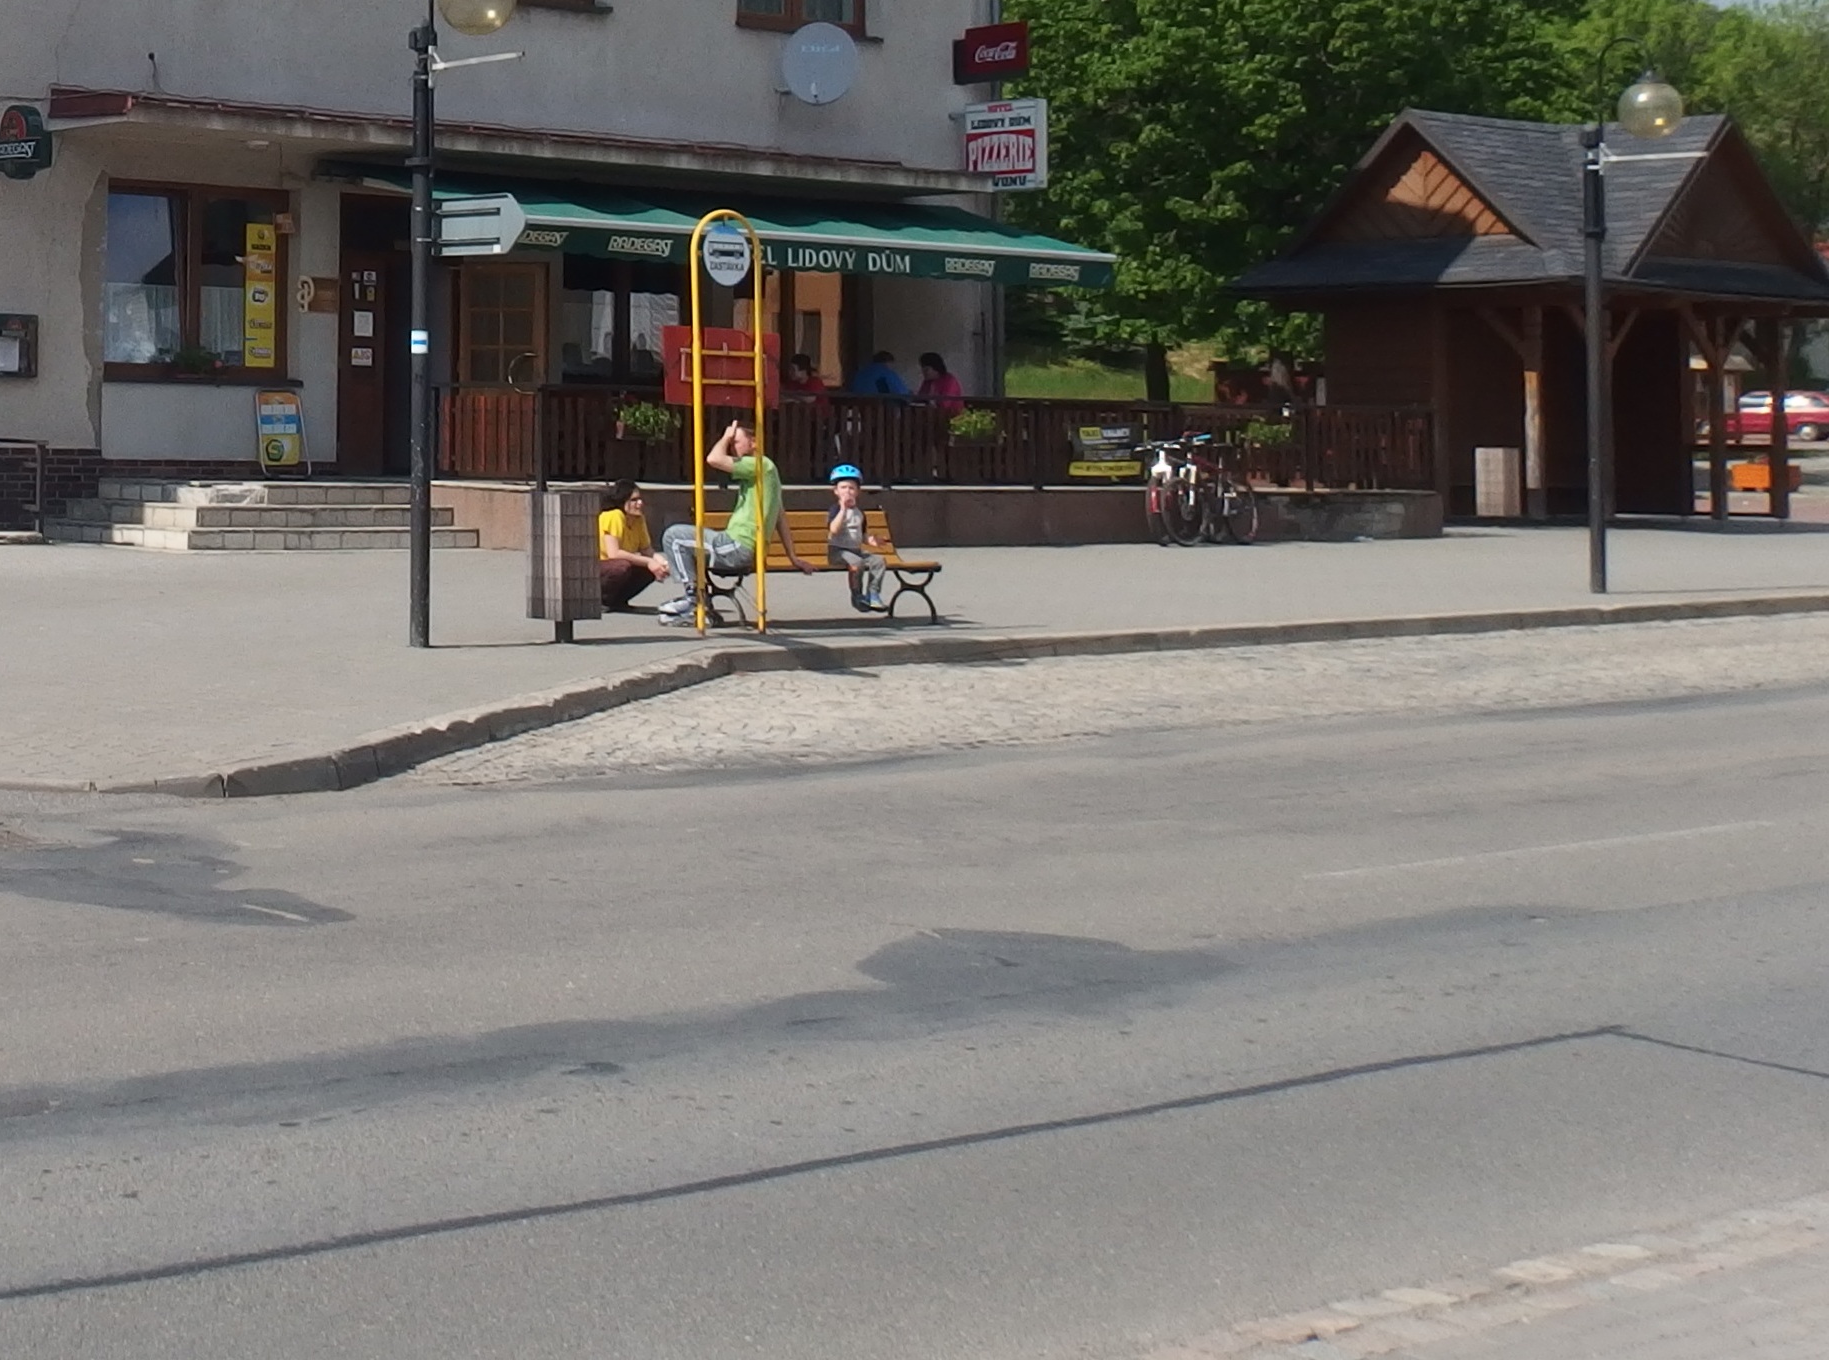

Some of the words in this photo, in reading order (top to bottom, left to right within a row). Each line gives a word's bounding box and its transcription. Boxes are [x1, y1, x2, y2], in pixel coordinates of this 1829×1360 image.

[975, 41, 1018, 63] Coca-Cola
[968, 134, 1033, 172] PIZZERIE
[517, 229, 570, 247] DEGAST
[607, 236, 674, 257] RADEGAST
[787, 247, 856, 270] LIDOVÝ
[868, 250, 911, 273] DŮM
